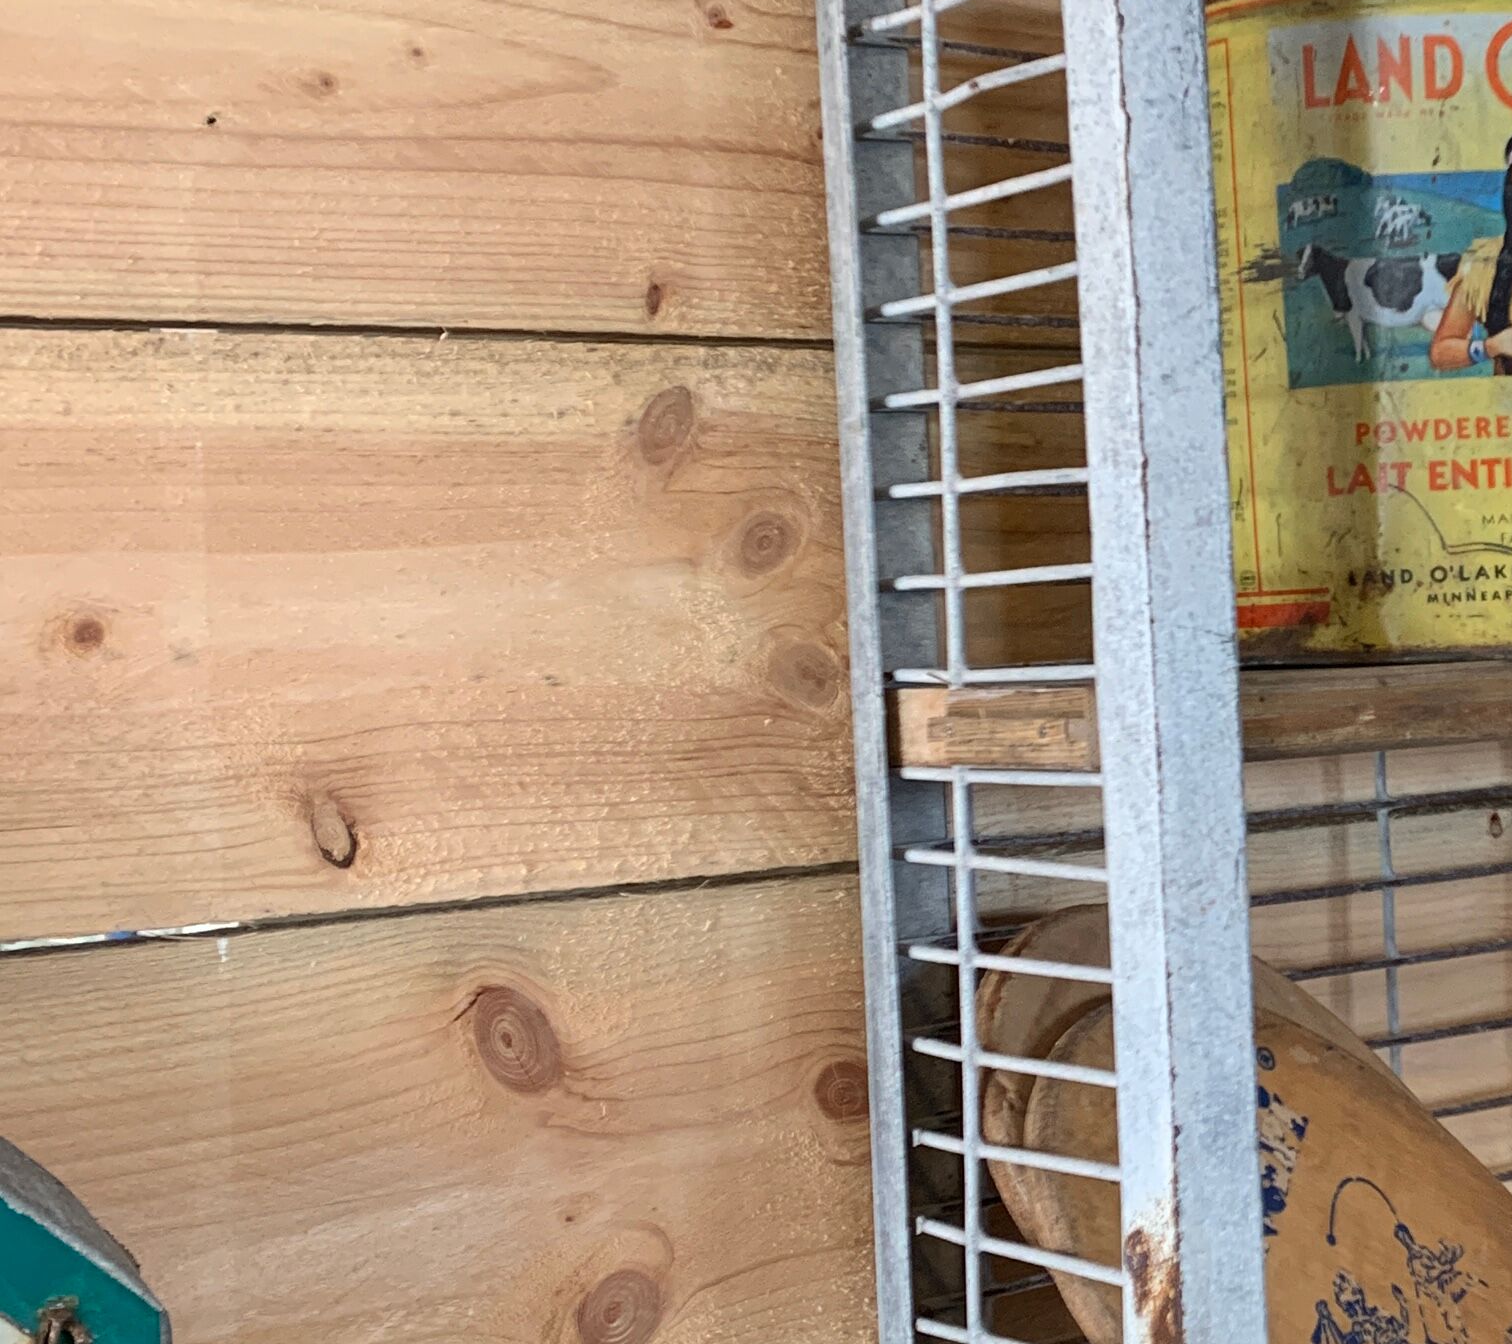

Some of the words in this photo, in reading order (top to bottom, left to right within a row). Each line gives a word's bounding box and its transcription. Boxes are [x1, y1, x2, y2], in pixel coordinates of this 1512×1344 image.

[1302, 32, 1465, 110] LAND
[1326, 461, 1413, 497] LAIT
[1347, 567, 1413, 587] LAND
